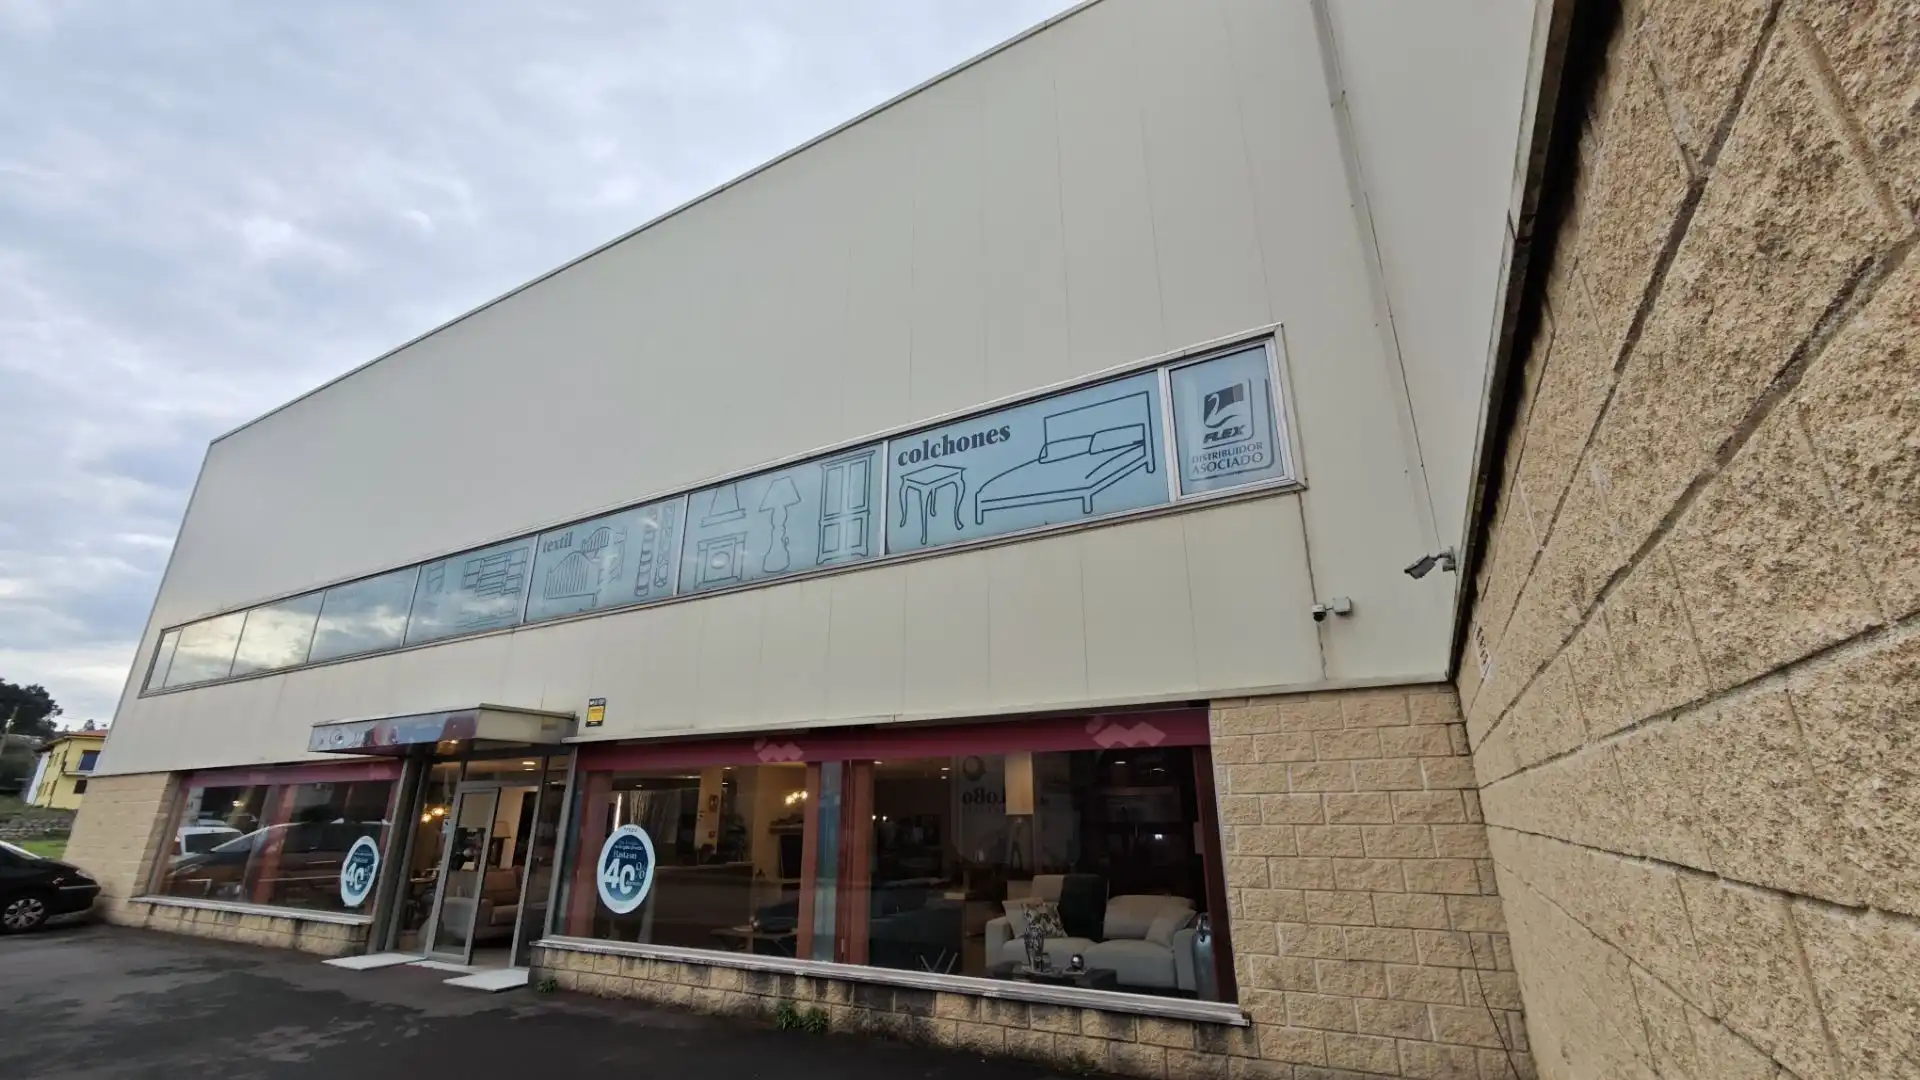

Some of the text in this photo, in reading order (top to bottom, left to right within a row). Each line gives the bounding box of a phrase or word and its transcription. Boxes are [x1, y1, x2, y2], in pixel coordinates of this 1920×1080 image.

[1203, 424, 1246, 444] FLEX
[897, 425, 1011, 467] colchones
[1192, 441, 1263, 463] DISTRIBUIDOR
[1192, 451, 1263, 475] ASOCIADO
[542, 530, 574, 553] textil
